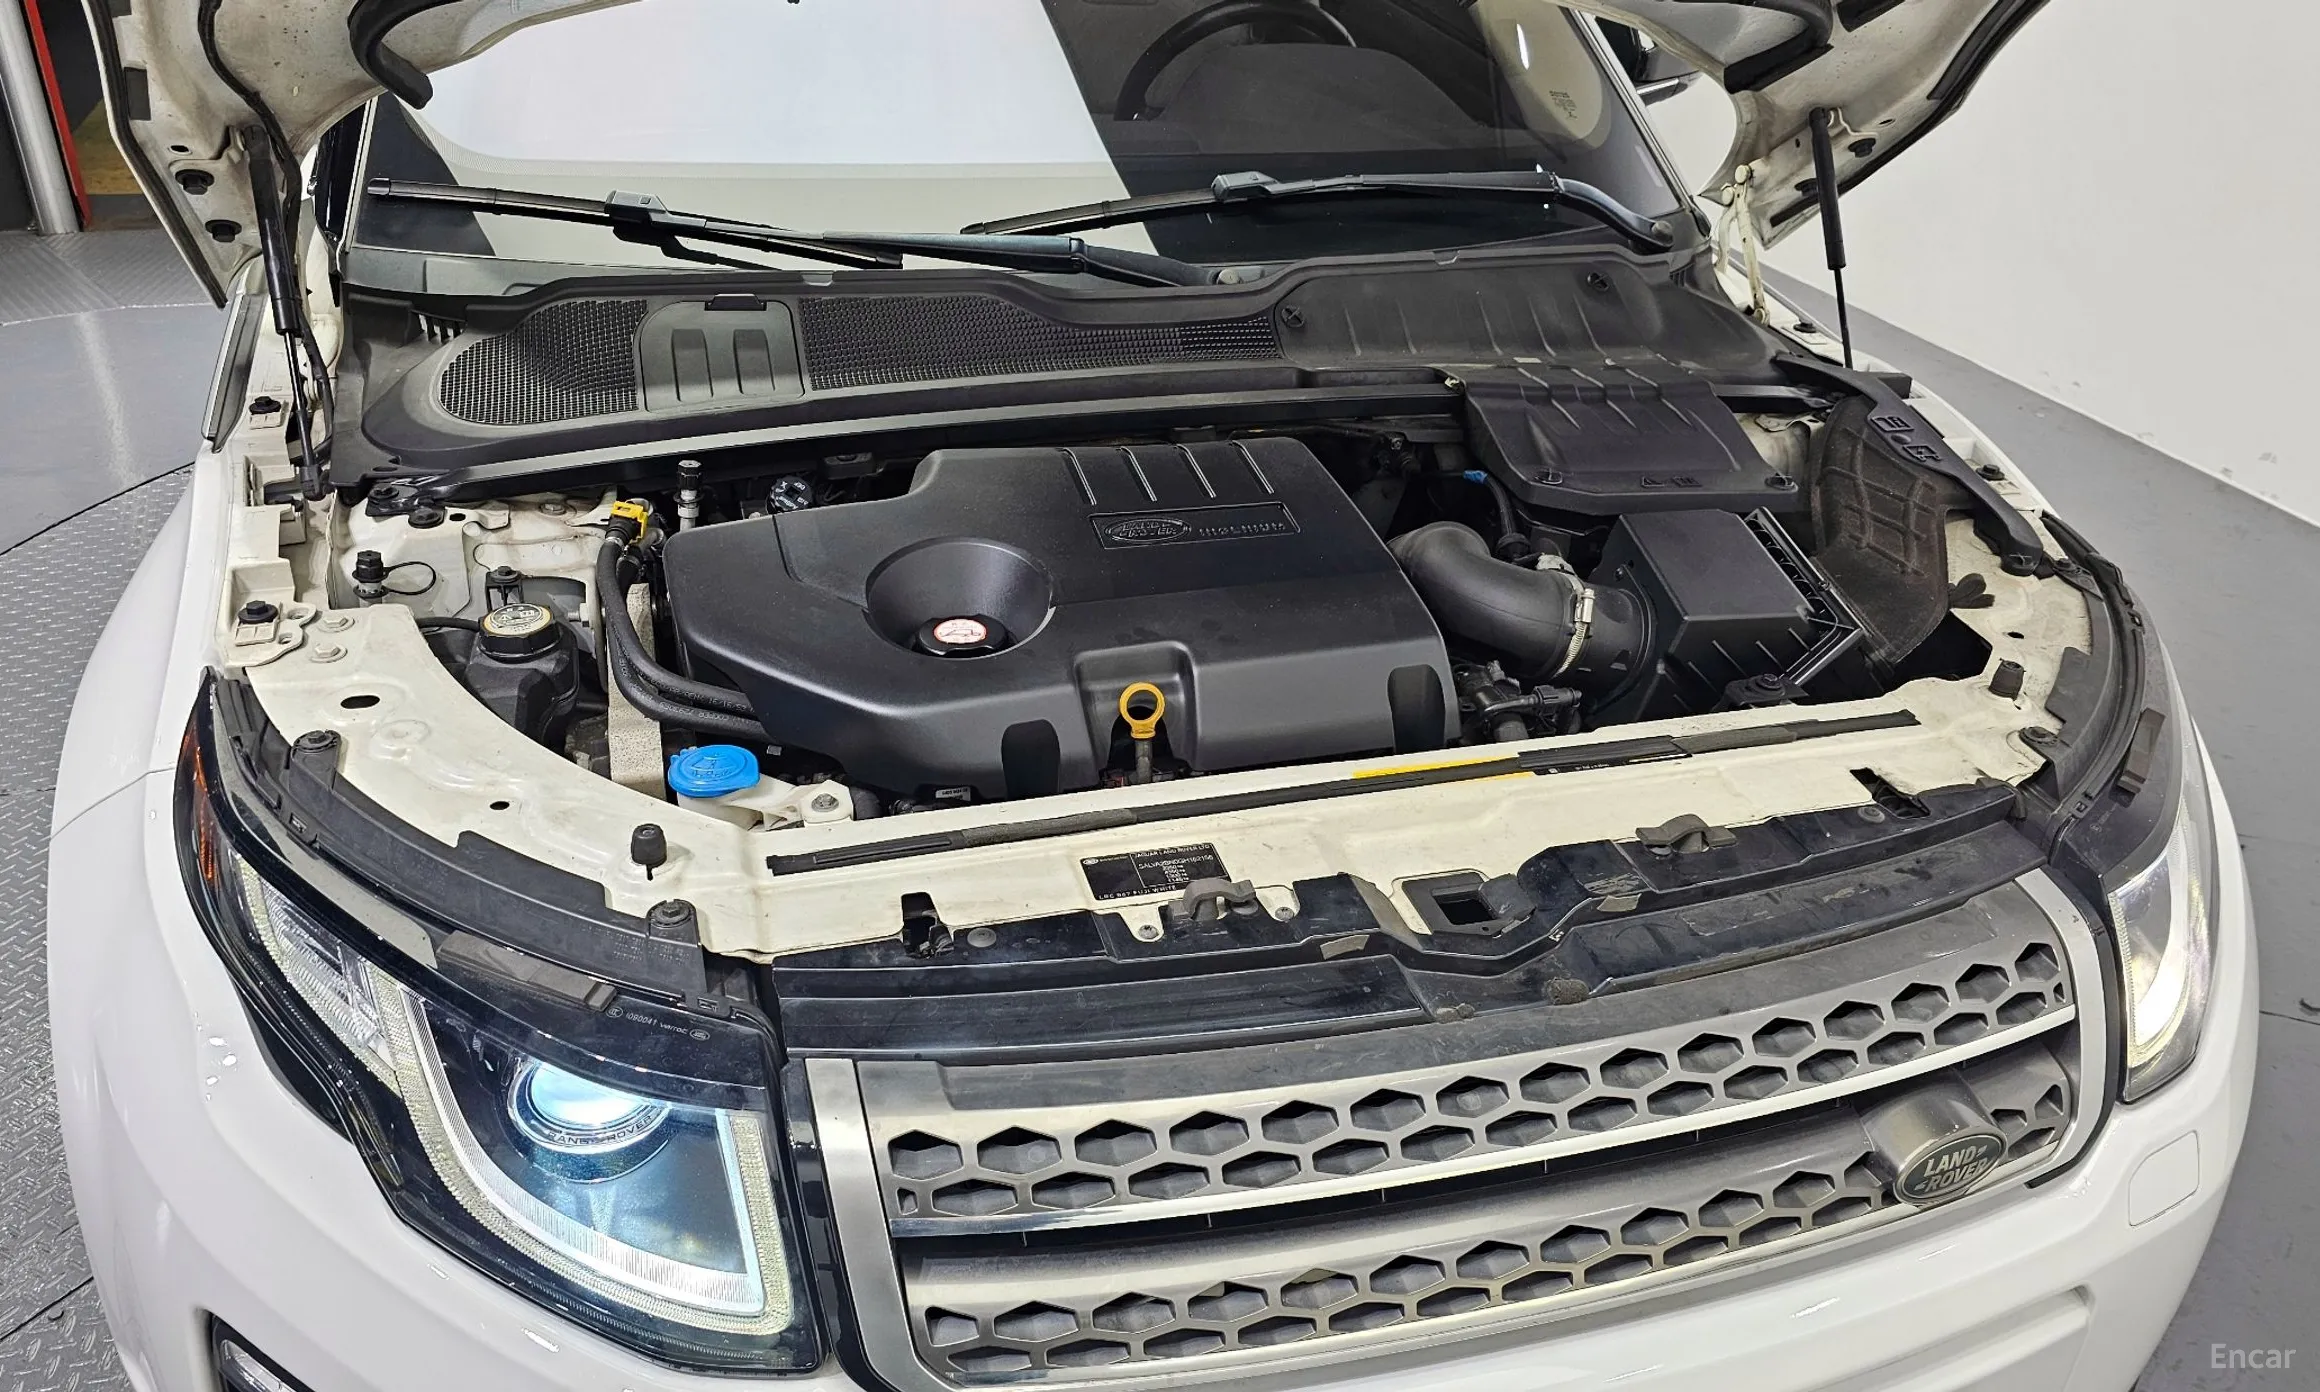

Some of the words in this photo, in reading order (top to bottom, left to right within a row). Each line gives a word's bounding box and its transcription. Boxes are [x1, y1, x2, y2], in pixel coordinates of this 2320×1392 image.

[606, 1115, 652, 1141] ROVER
[1924, 1146, 1977, 1177] LAND
[1925, 1157, 1990, 1192] ROVER
